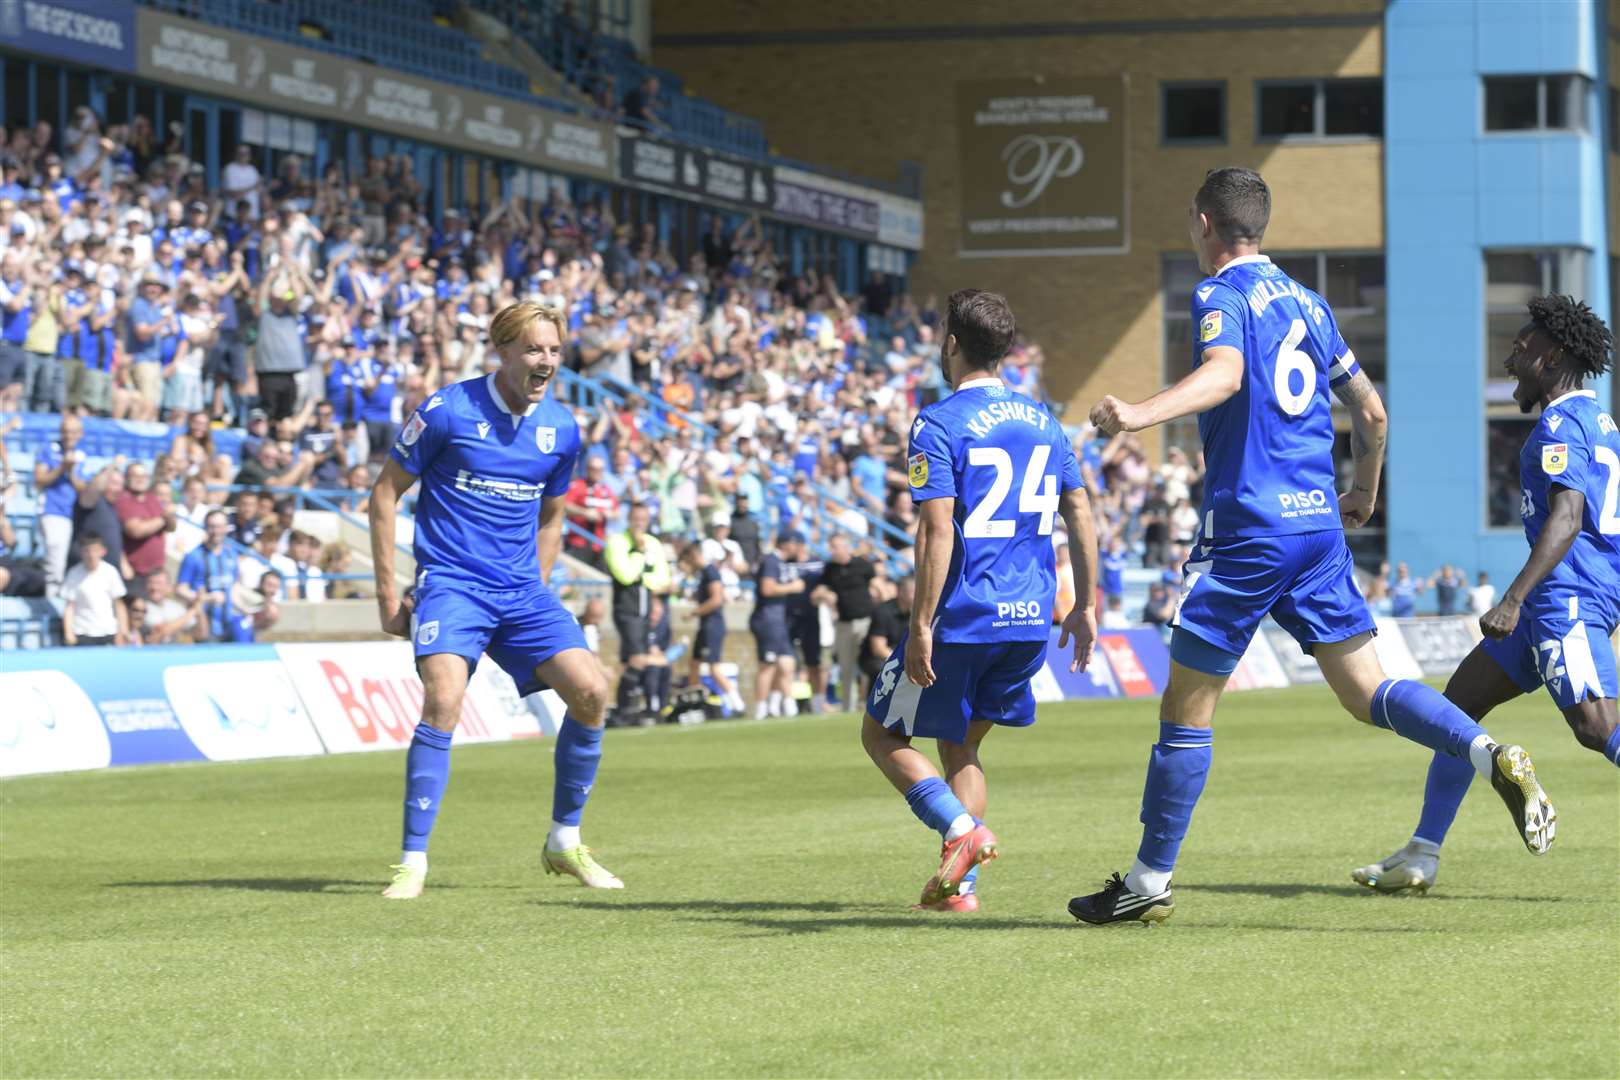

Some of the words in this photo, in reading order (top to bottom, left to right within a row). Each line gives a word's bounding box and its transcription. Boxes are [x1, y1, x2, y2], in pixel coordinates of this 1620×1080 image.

[1274, 318, 1317, 416] 6
[966, 401, 1049, 438] KASHKET
[963, 445, 1060, 538] 24
[1277, 488, 1327, 510] PISO
[991, 620, 1010, 628] MORE
[1010, 619, 1028, 627] THAN
[997, 600, 1041, 619] PISO
